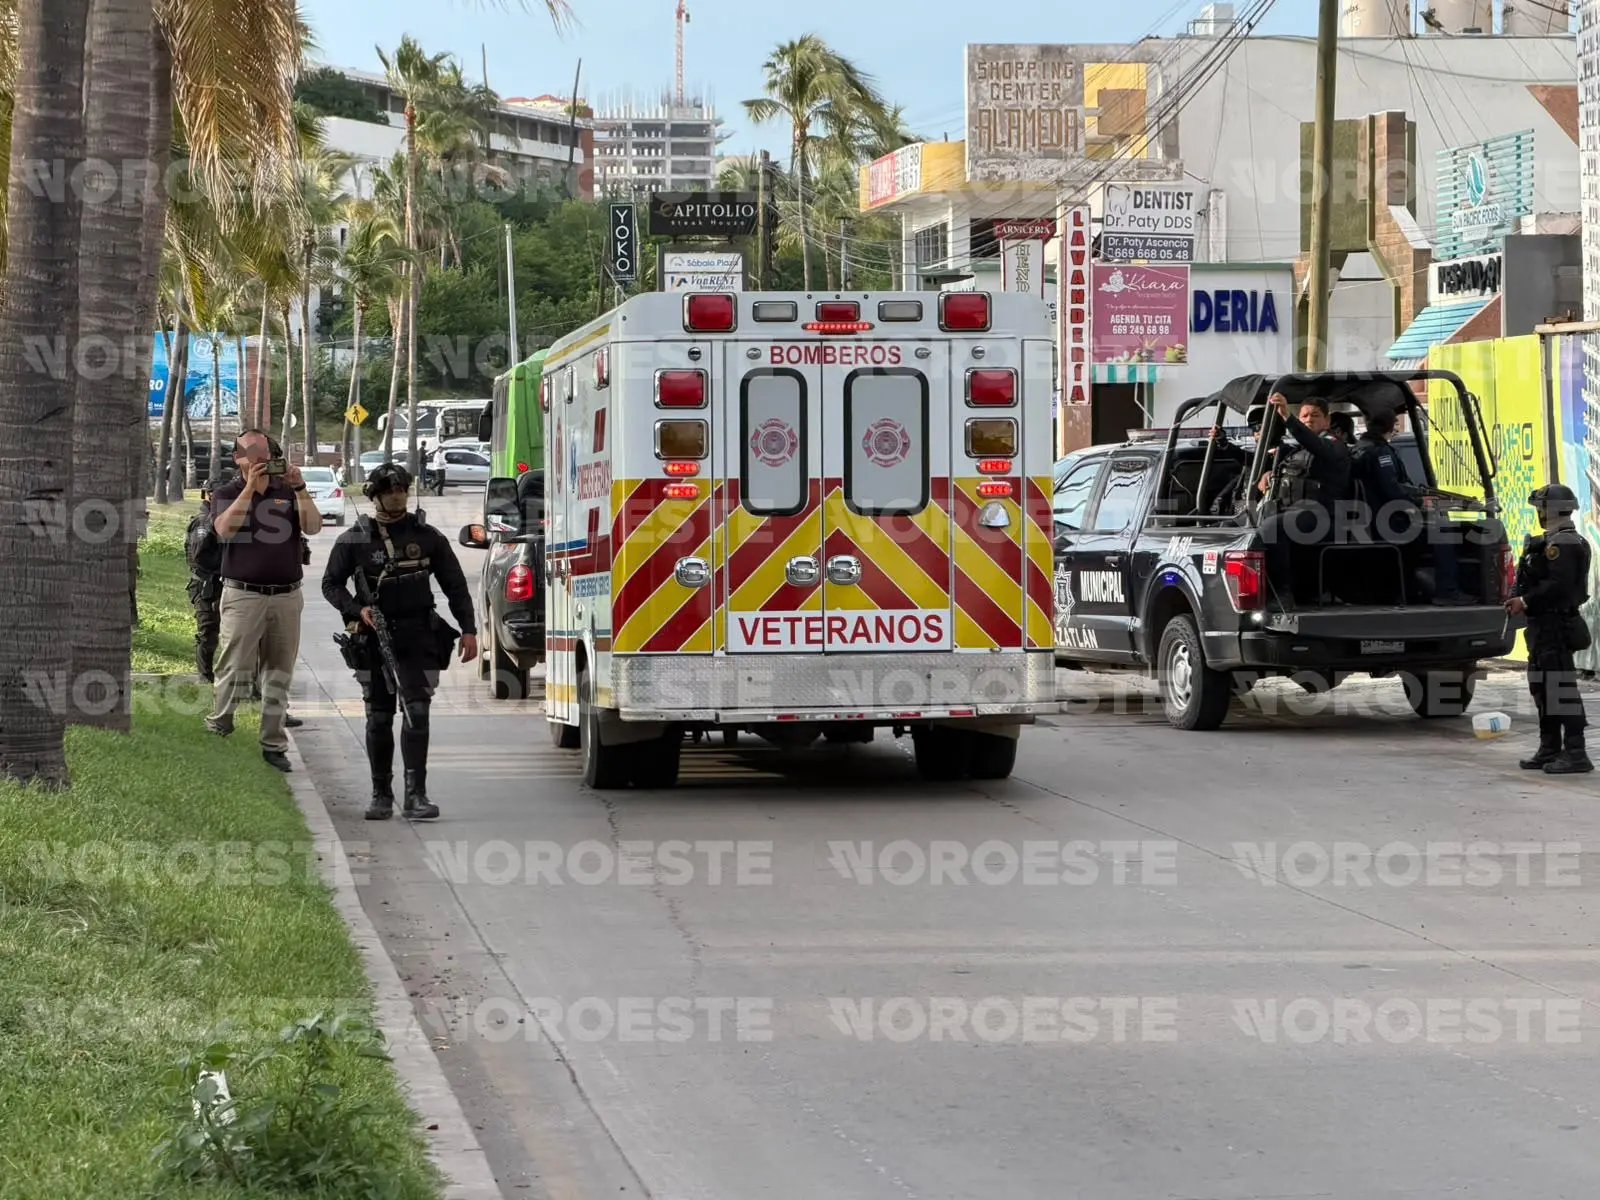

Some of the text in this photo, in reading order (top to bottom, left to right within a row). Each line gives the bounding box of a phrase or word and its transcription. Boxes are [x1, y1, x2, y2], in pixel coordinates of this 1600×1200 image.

[977, 61, 1074, 80] SHOPPING
[990, 82, 1062, 101] CENTER
[975, 108, 1079, 151] ALAMEDA
[1133, 190, 1194, 210] DENTIST
[660, 202, 755, 218] CAPITOLIO
[1105, 215, 1193, 231] Dr. Paty DDS
[615, 208, 631, 272] YOKO
[1108, 237, 1189, 249] Dr. Paty Ascencio
[1115, 249, 1189, 260] 669 668 05 48
[1127, 273, 1185, 293] Kiara
[1110, 314, 1172, 325] AGENDA TU CITA
[1190, 289, 1279, 334] DERIA
[1112, 325, 1128, 335] 669
[1159, 325, 1170, 335] 98
[770, 345, 902, 366] BOMBEROS
[1080, 571, 1125, 603] MUNICIPAL
[738, 613, 944, 646] VETERANOS
